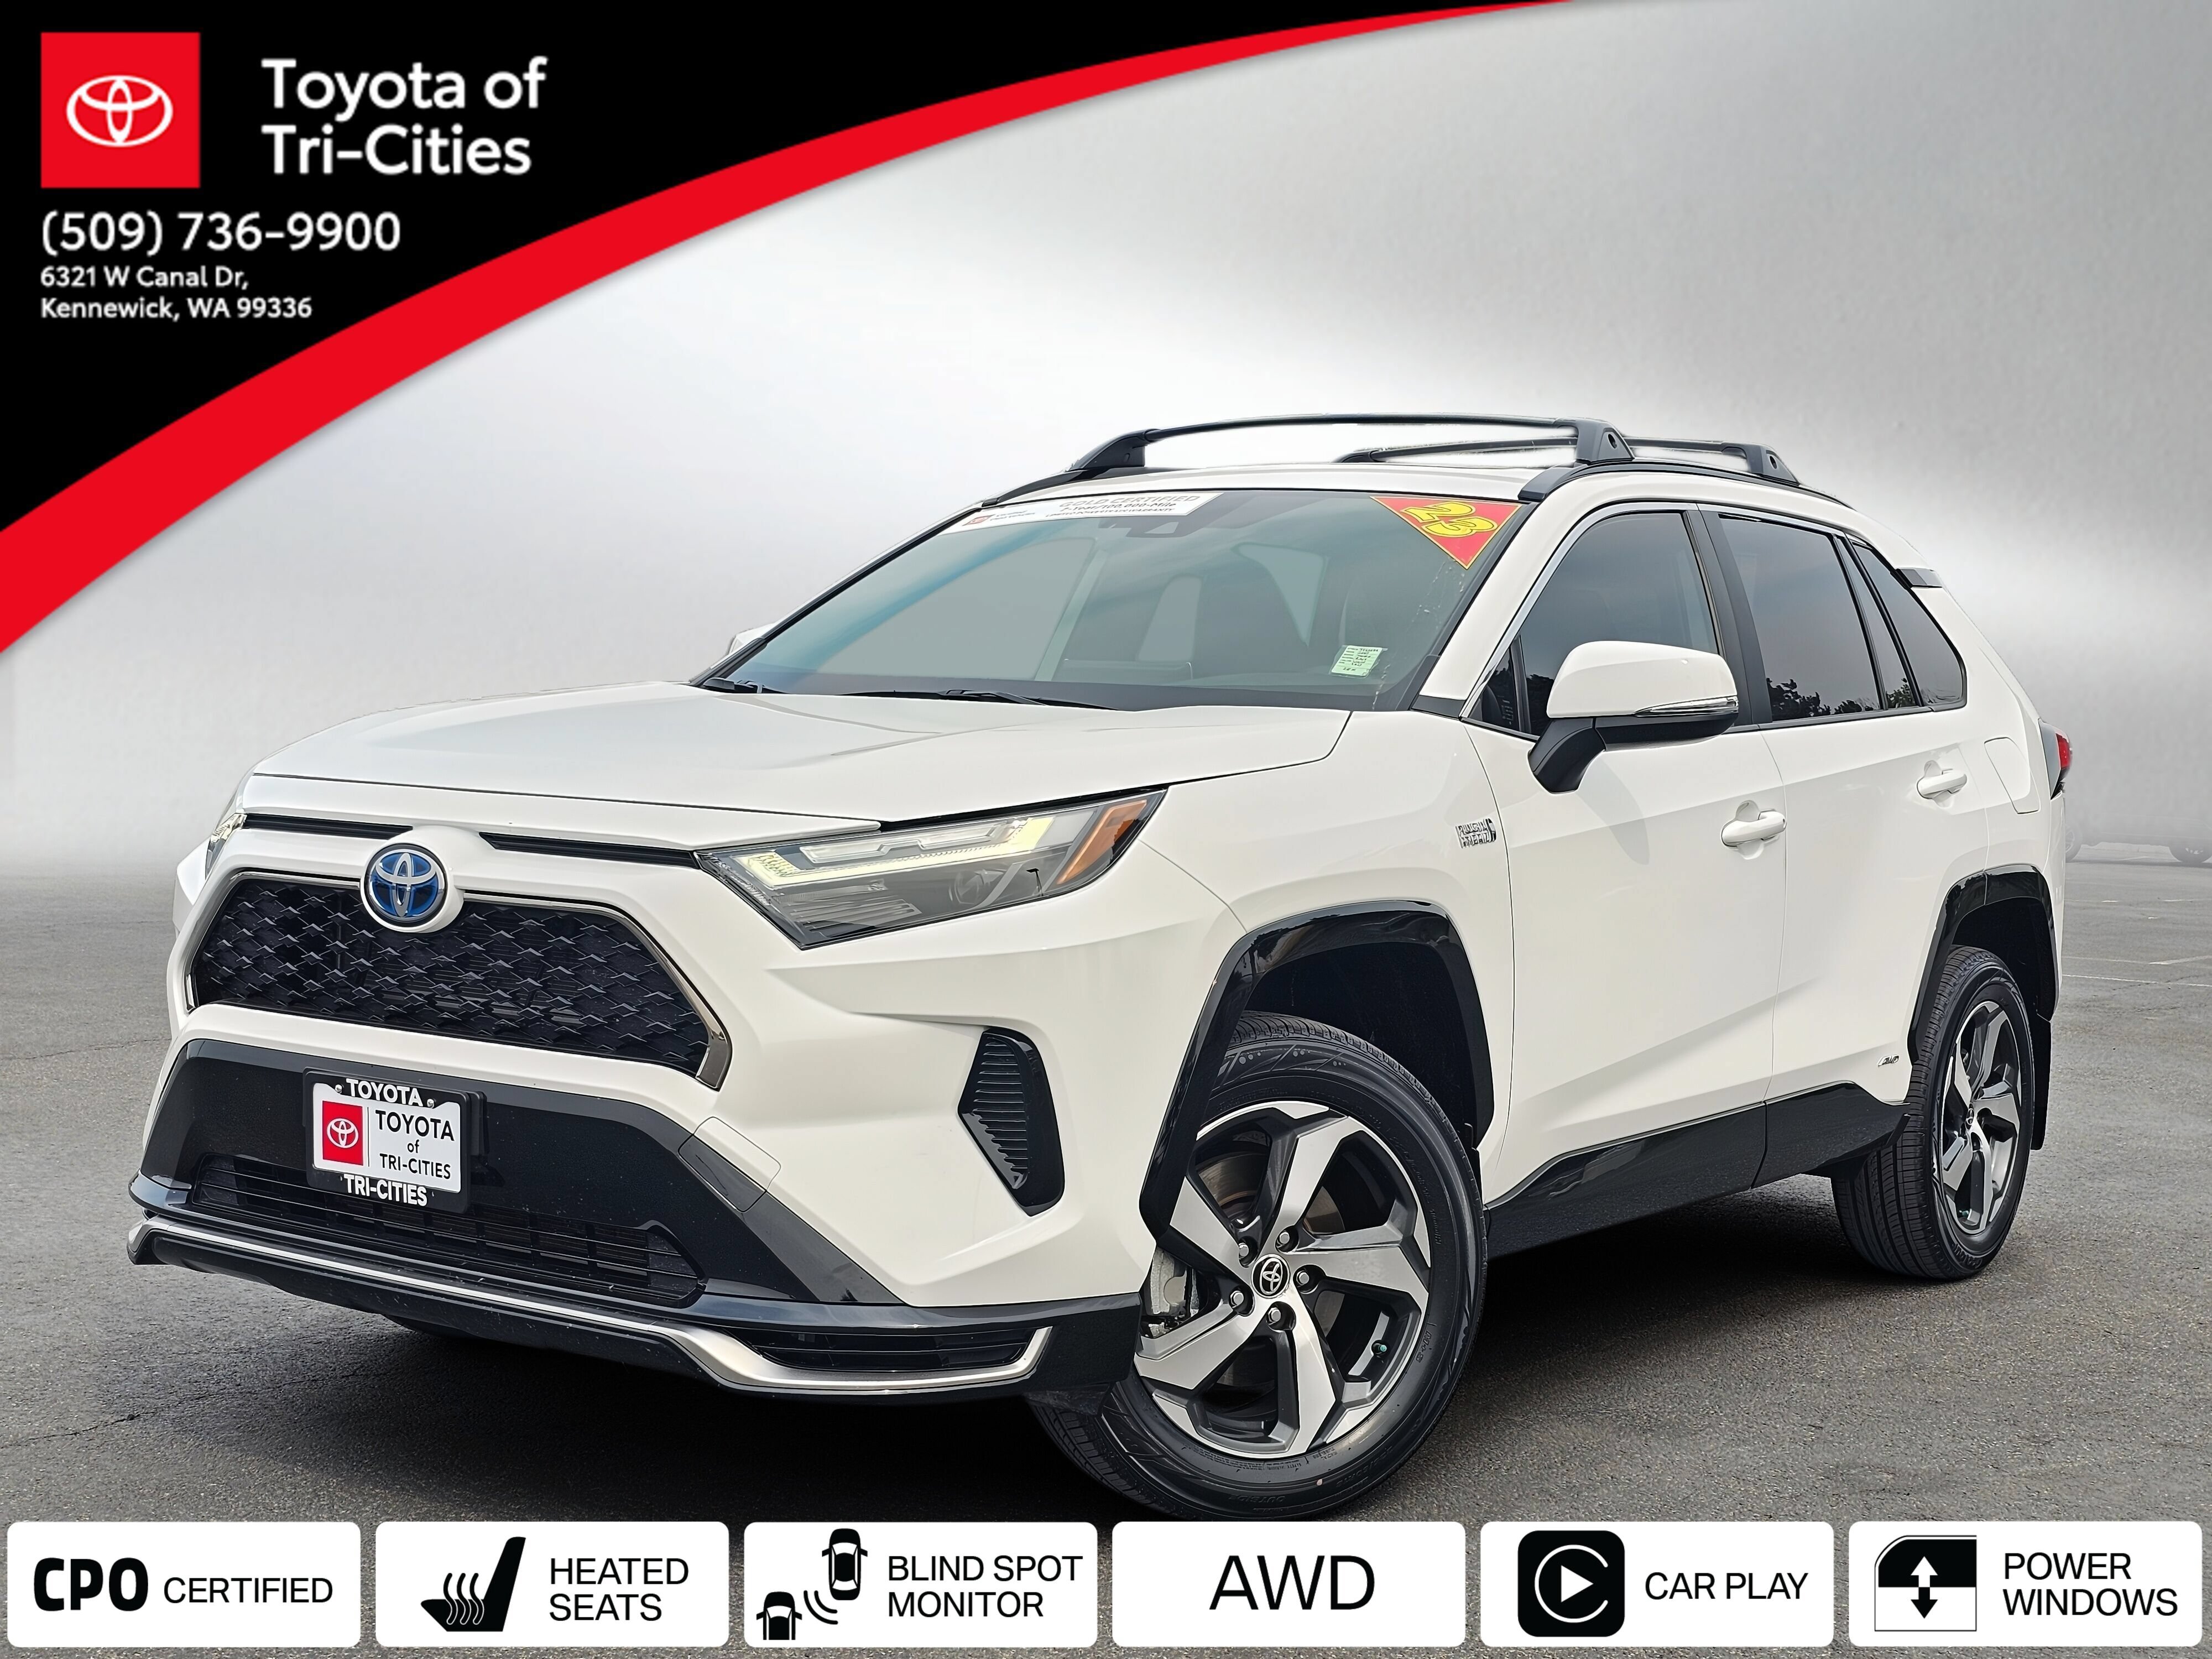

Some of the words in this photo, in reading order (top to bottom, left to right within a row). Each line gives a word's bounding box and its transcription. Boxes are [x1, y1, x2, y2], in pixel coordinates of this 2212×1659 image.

[1060, 499, 1109, 507] GOLD
[1110, 495, 1201, 504] CERTIFIED
[1401, 501, 1498, 538] 23
[346, 1078, 424, 1107] TOYOTA
[375, 1109, 455, 1141] TOYOTA
[407, 1139, 420, 1154] of
[379, 1153, 451, 1180] TRI-CITIES
[343, 1174, 428, 1207] TRI-CITIES
